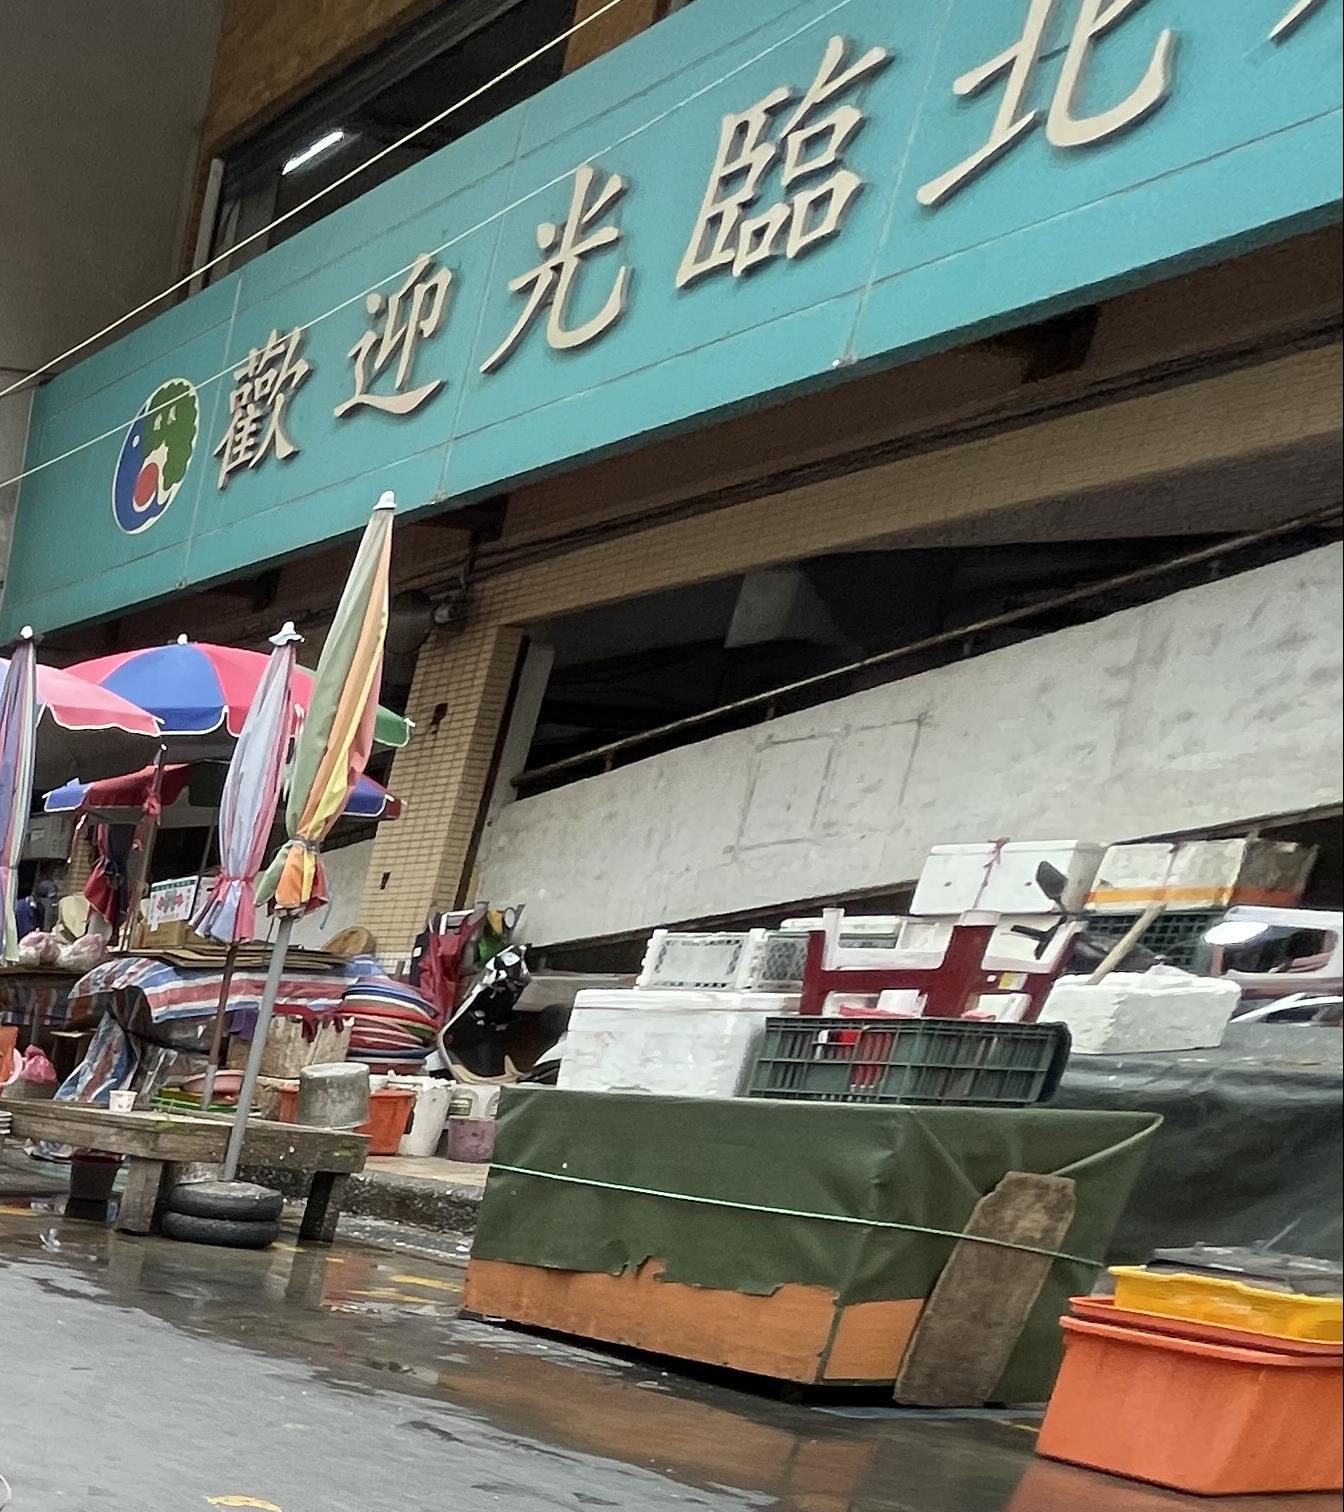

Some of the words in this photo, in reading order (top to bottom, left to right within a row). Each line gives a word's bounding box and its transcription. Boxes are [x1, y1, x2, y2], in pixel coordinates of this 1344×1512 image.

[214, 0, 1342, 490] 歡迎光臨北
